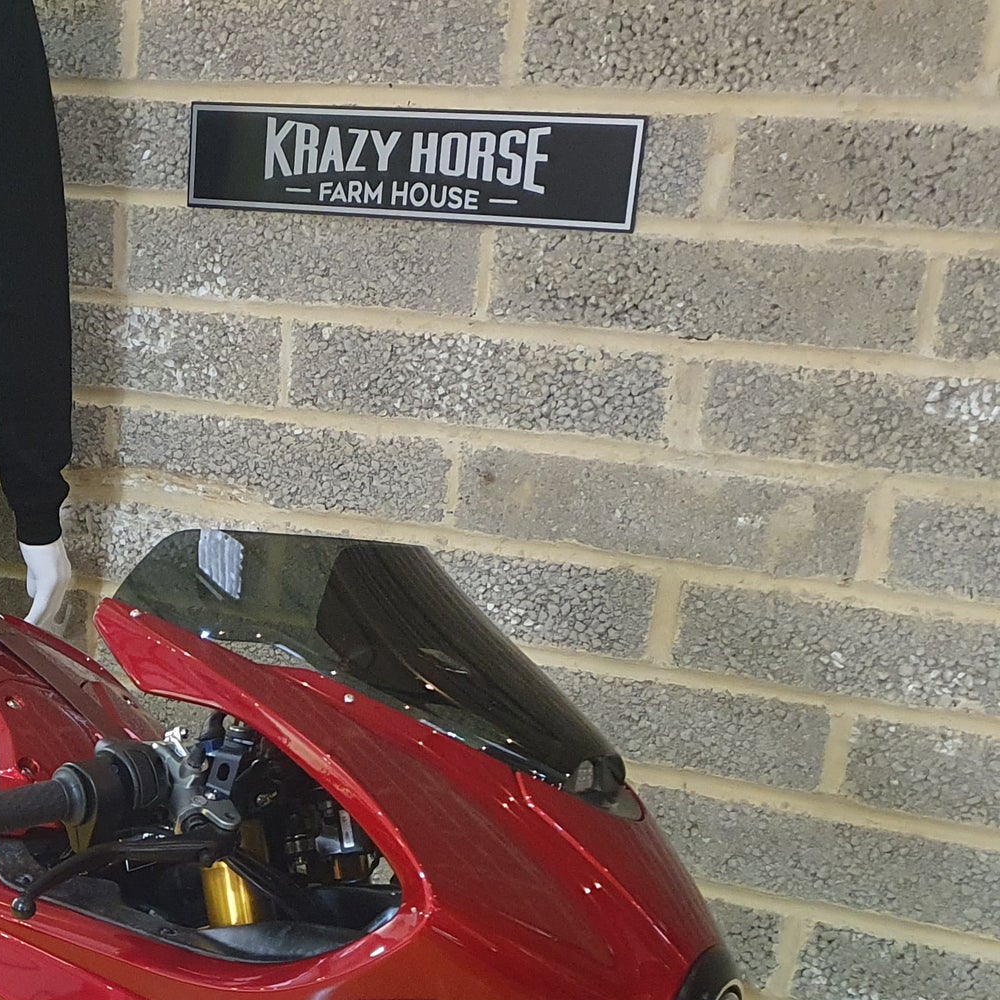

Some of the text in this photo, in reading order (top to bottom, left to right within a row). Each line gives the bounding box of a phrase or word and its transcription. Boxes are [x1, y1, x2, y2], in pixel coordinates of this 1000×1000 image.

[264, 116, 552, 195] KRAZY HORSE
[318, 180, 480, 211] FARM HOUSE
